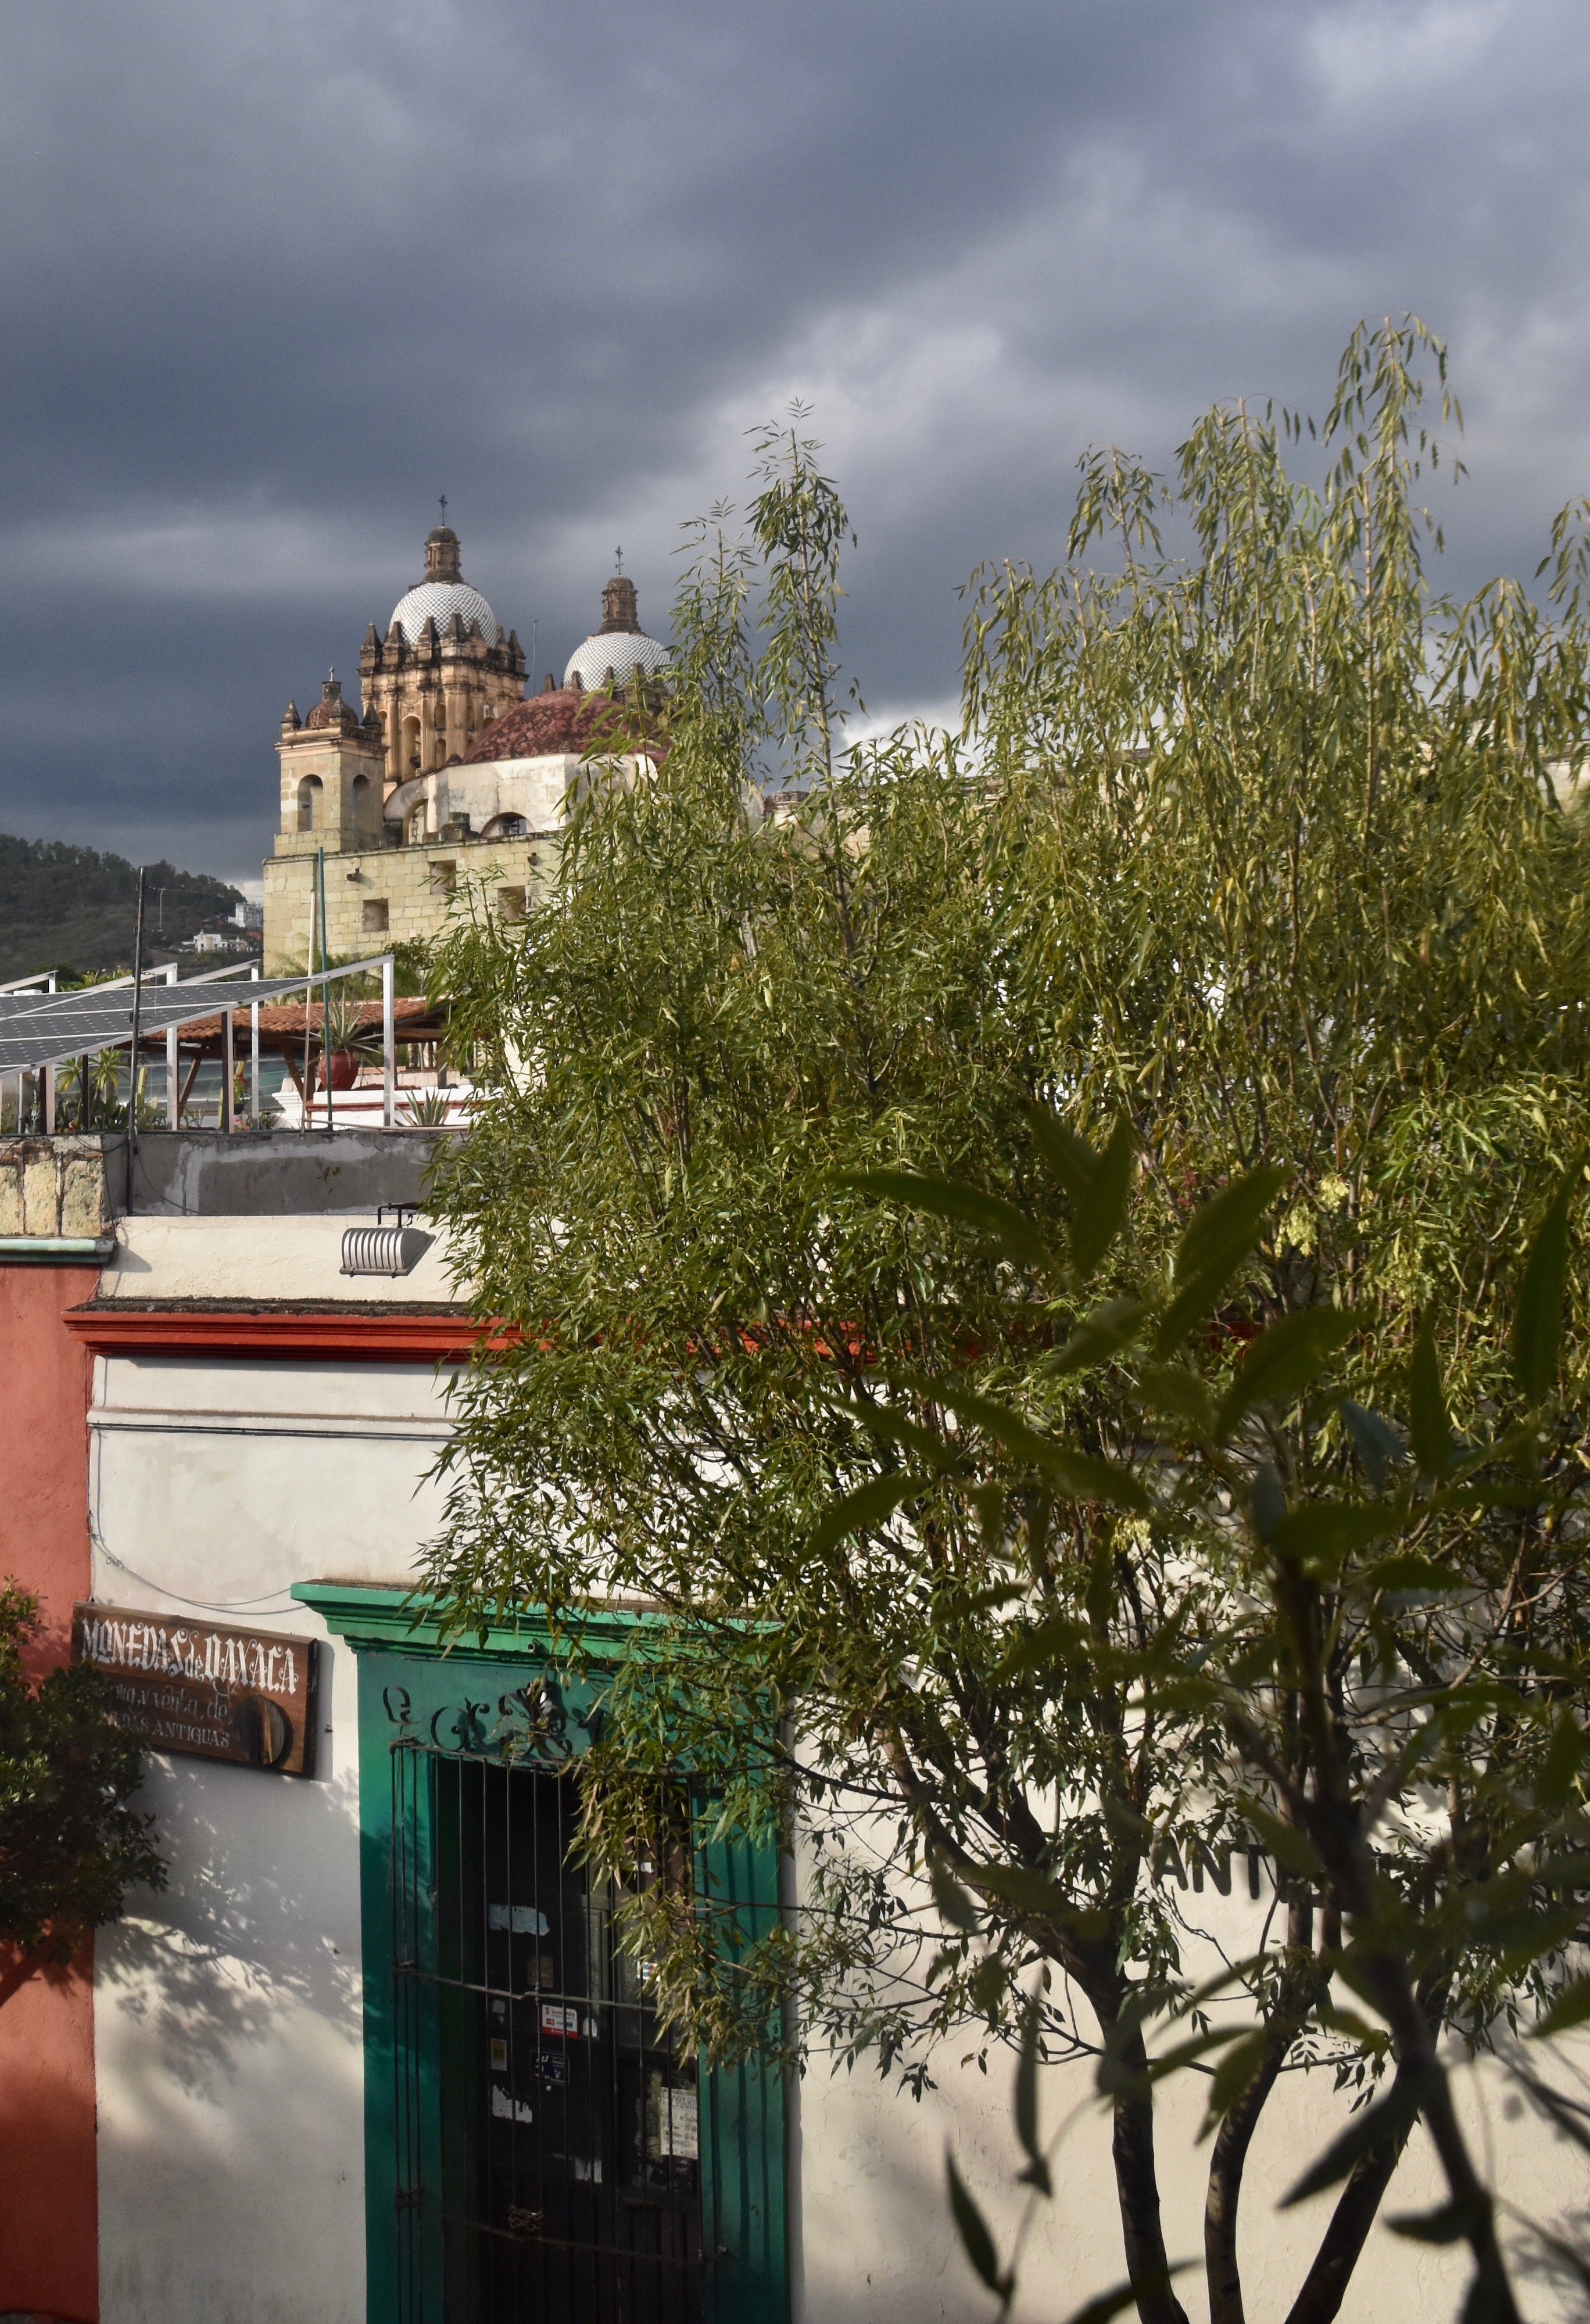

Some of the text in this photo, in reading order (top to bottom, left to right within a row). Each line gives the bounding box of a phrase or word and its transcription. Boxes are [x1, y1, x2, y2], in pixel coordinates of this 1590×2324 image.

[81, 1617, 298, 1696] MONEDAS de OAXACA
[152, 1719, 230, 1748] ANTIGUAS
